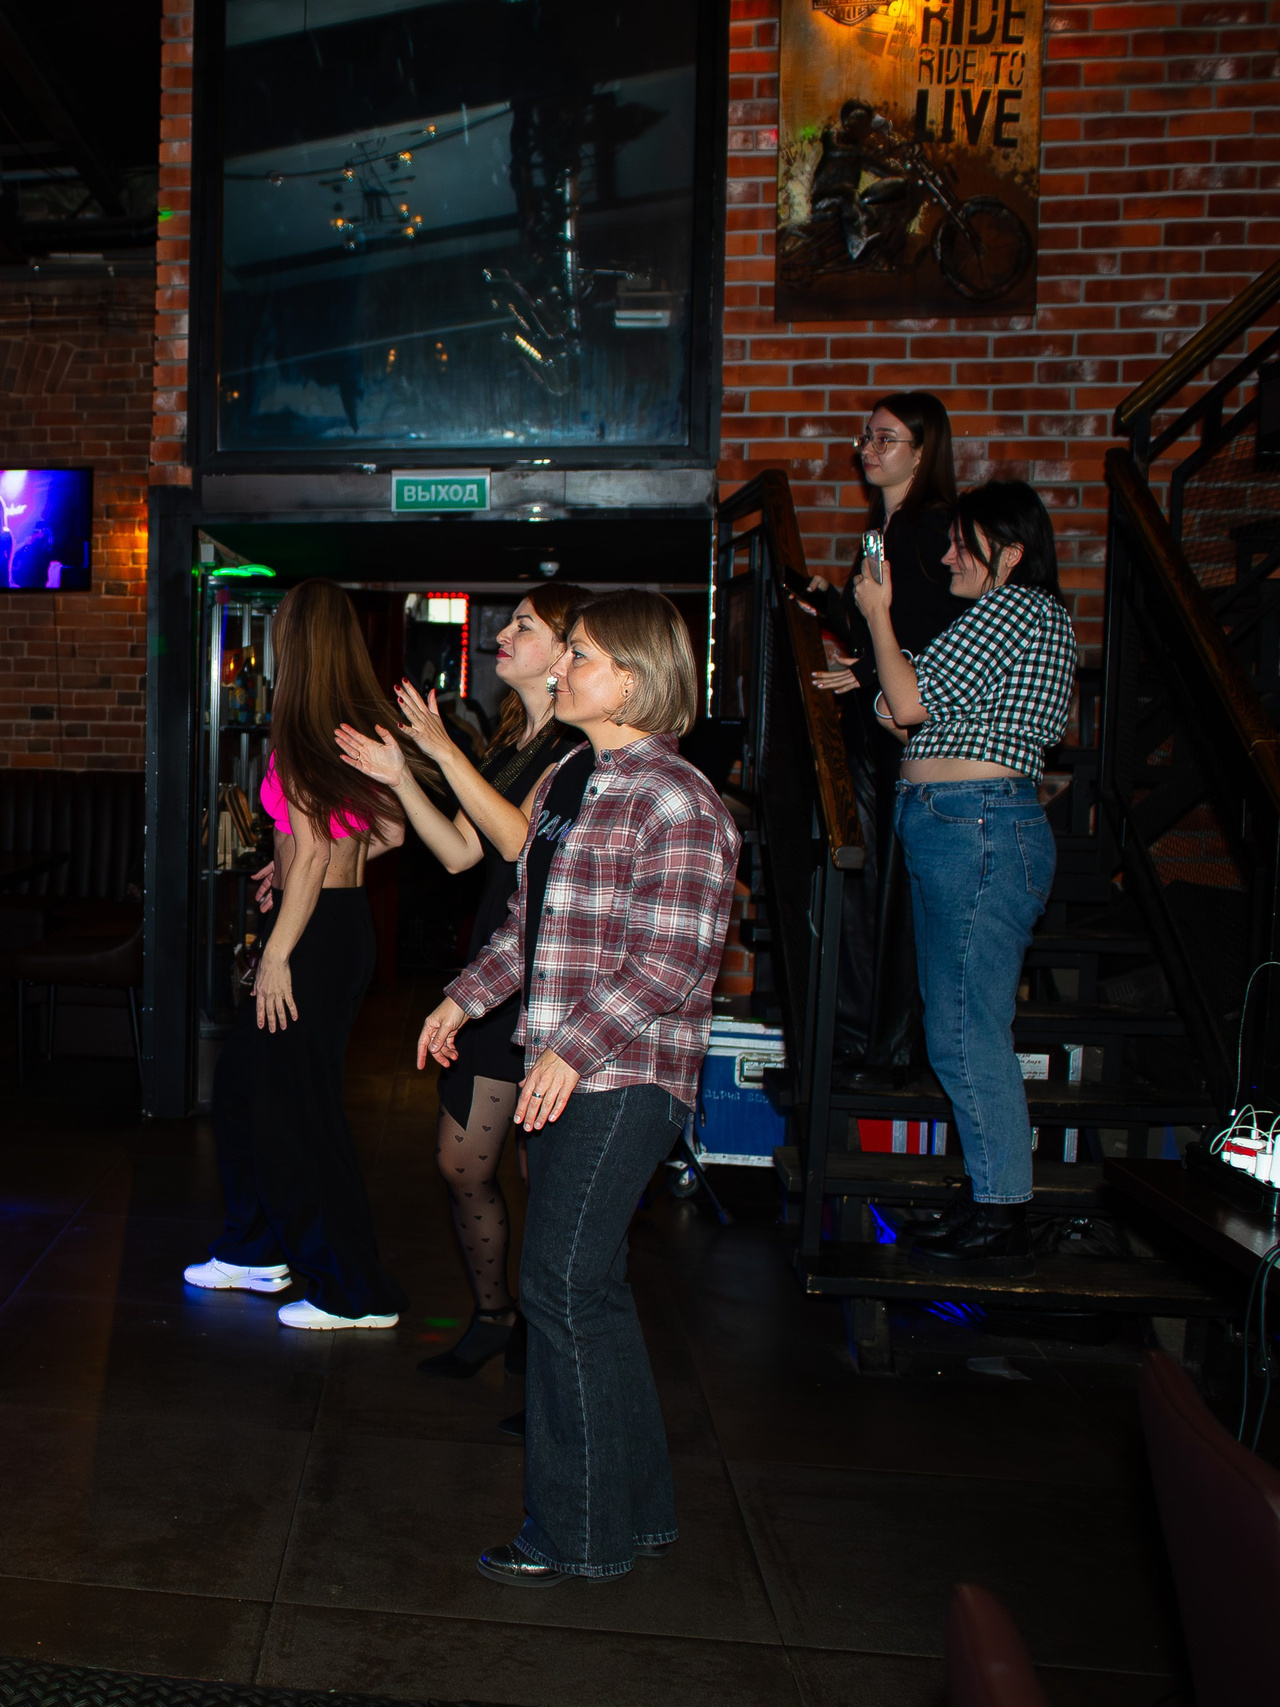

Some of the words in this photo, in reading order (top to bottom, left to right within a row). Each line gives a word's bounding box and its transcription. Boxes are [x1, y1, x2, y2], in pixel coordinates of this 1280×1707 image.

[921, 0, 1027, 45] RIDE
[918, 49, 977, 85] RIDE
[990, 50, 1026, 86] TO
[914, 88, 1023, 148] LIVE
[403, 484, 479, 504] ВЫХОД
